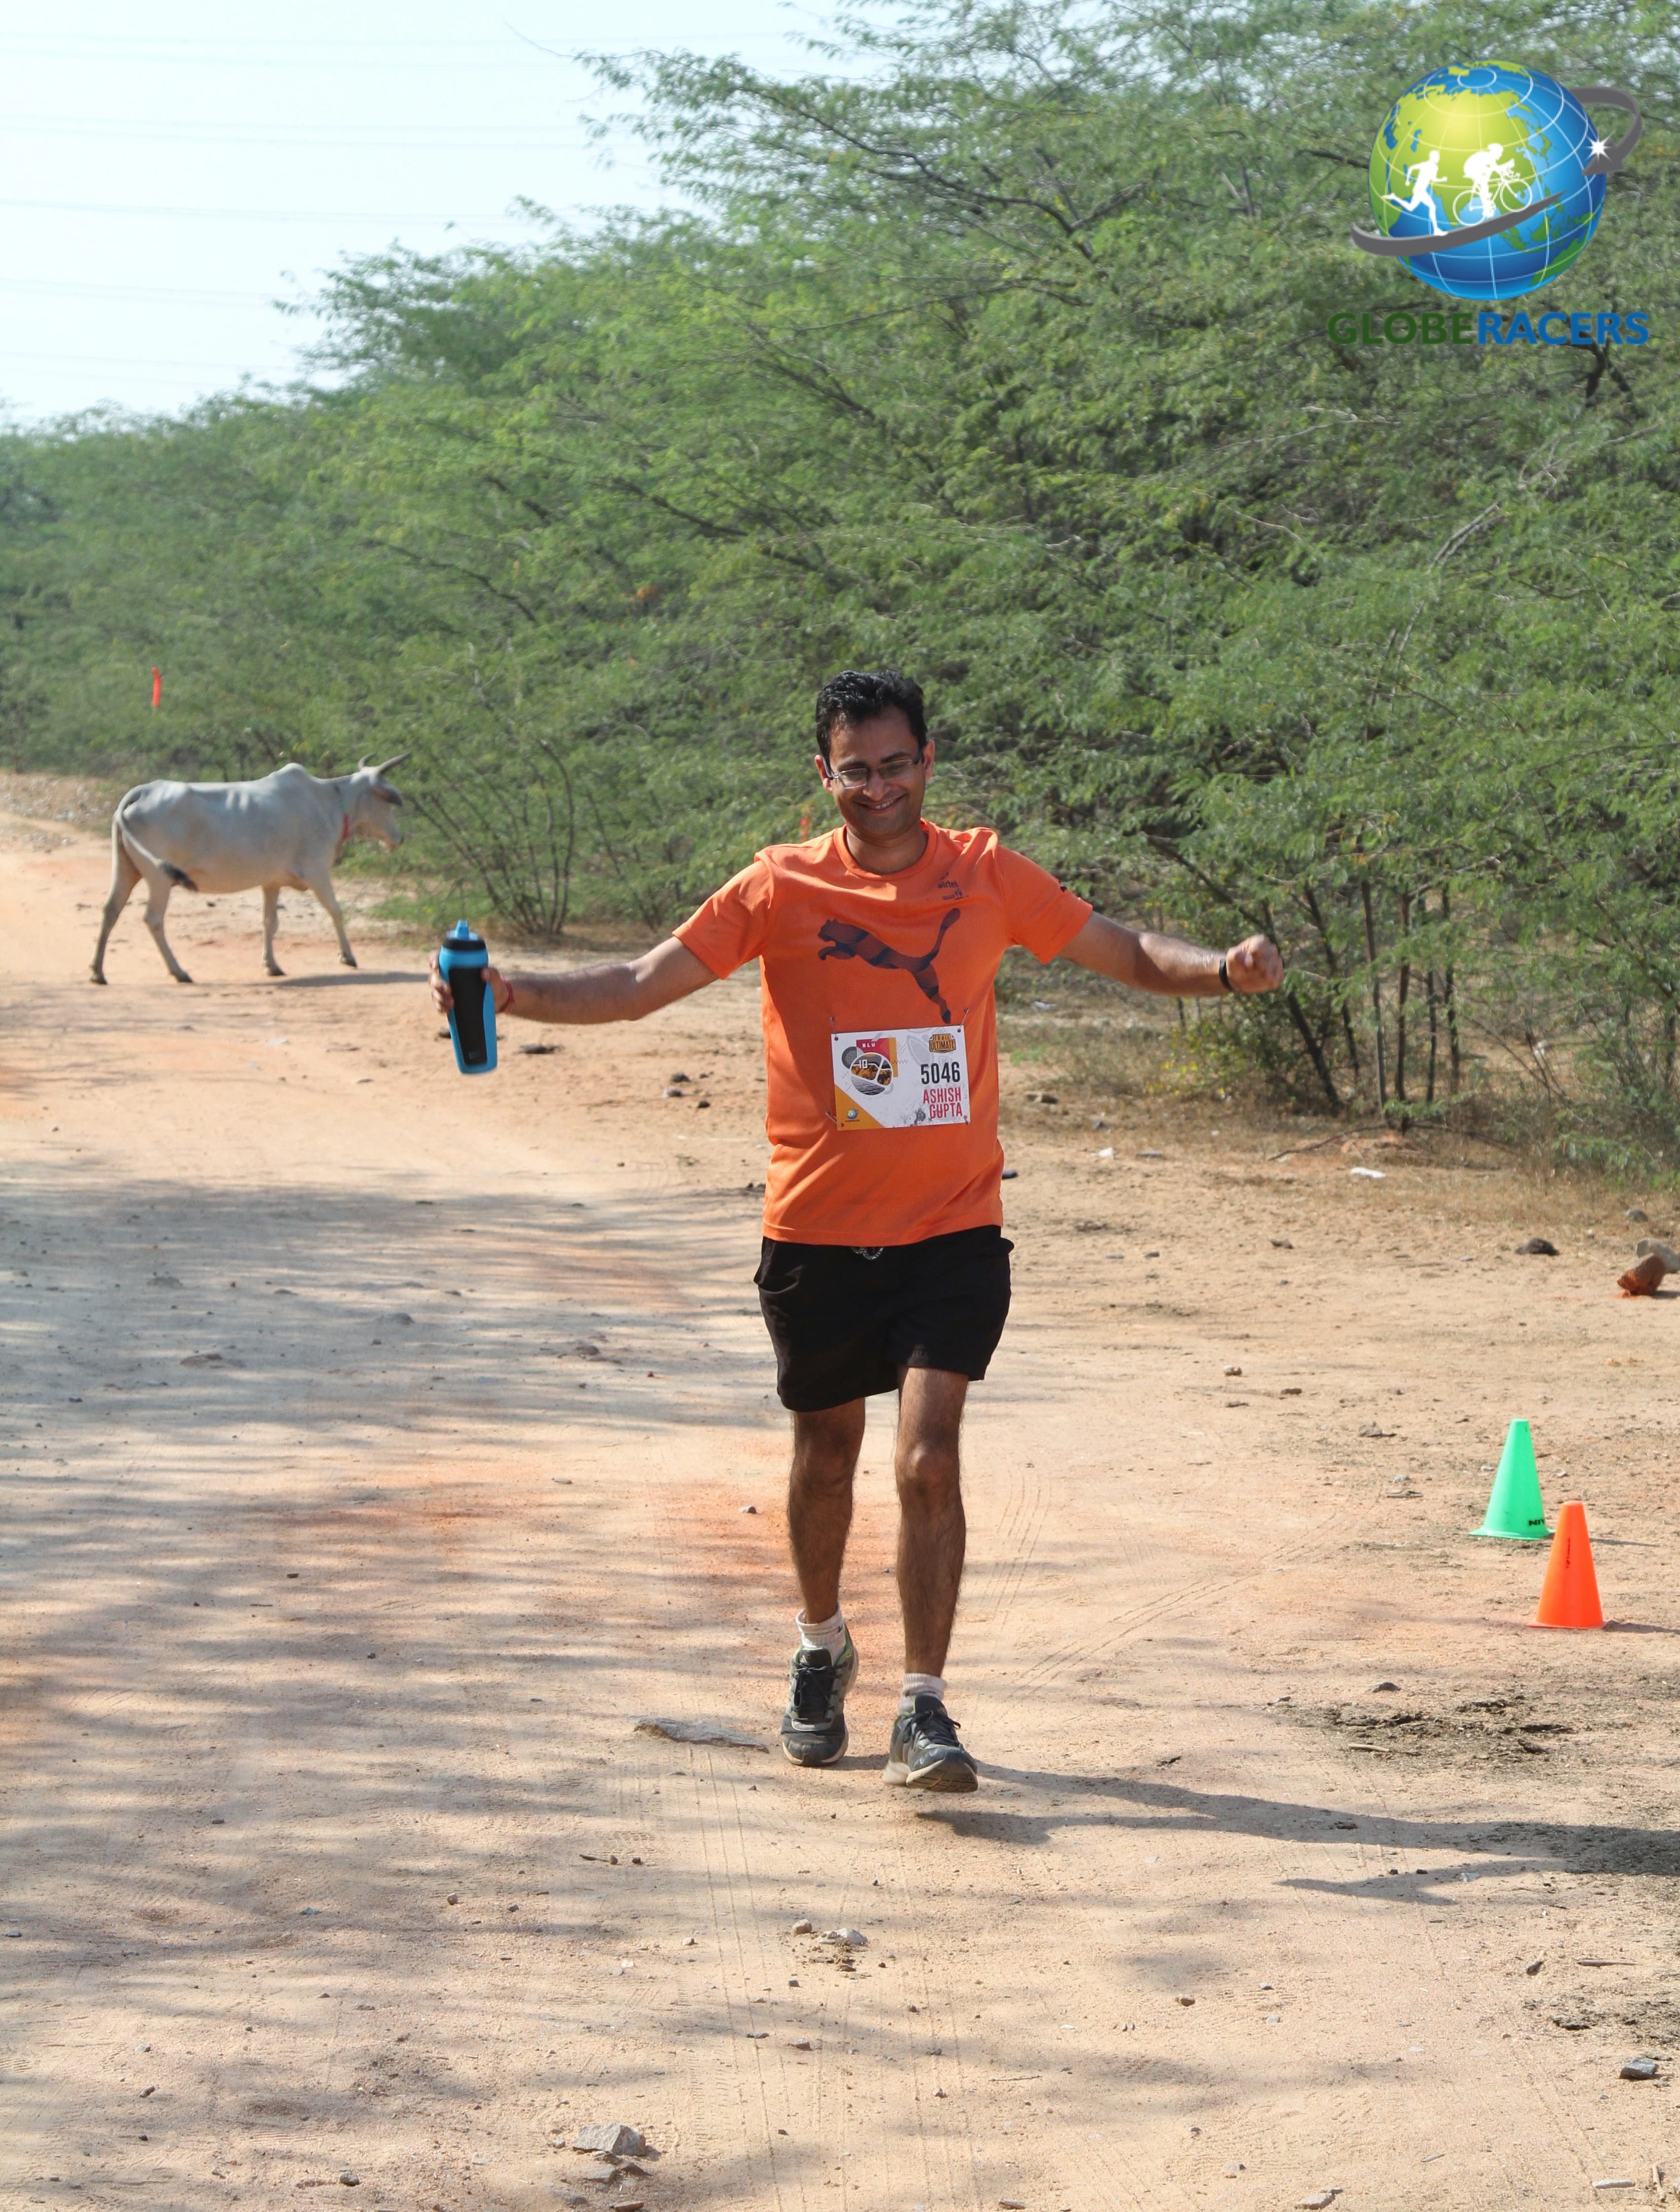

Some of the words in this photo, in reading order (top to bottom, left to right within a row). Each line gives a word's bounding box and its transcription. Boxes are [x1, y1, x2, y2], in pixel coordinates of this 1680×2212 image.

[930, 1040, 955, 1050] ULTIMATE
[921, 1062, 960, 1084] 5046
[923, 1087, 961, 1104] ASHISH
[929, 1103, 962, 1119] GUPTA
